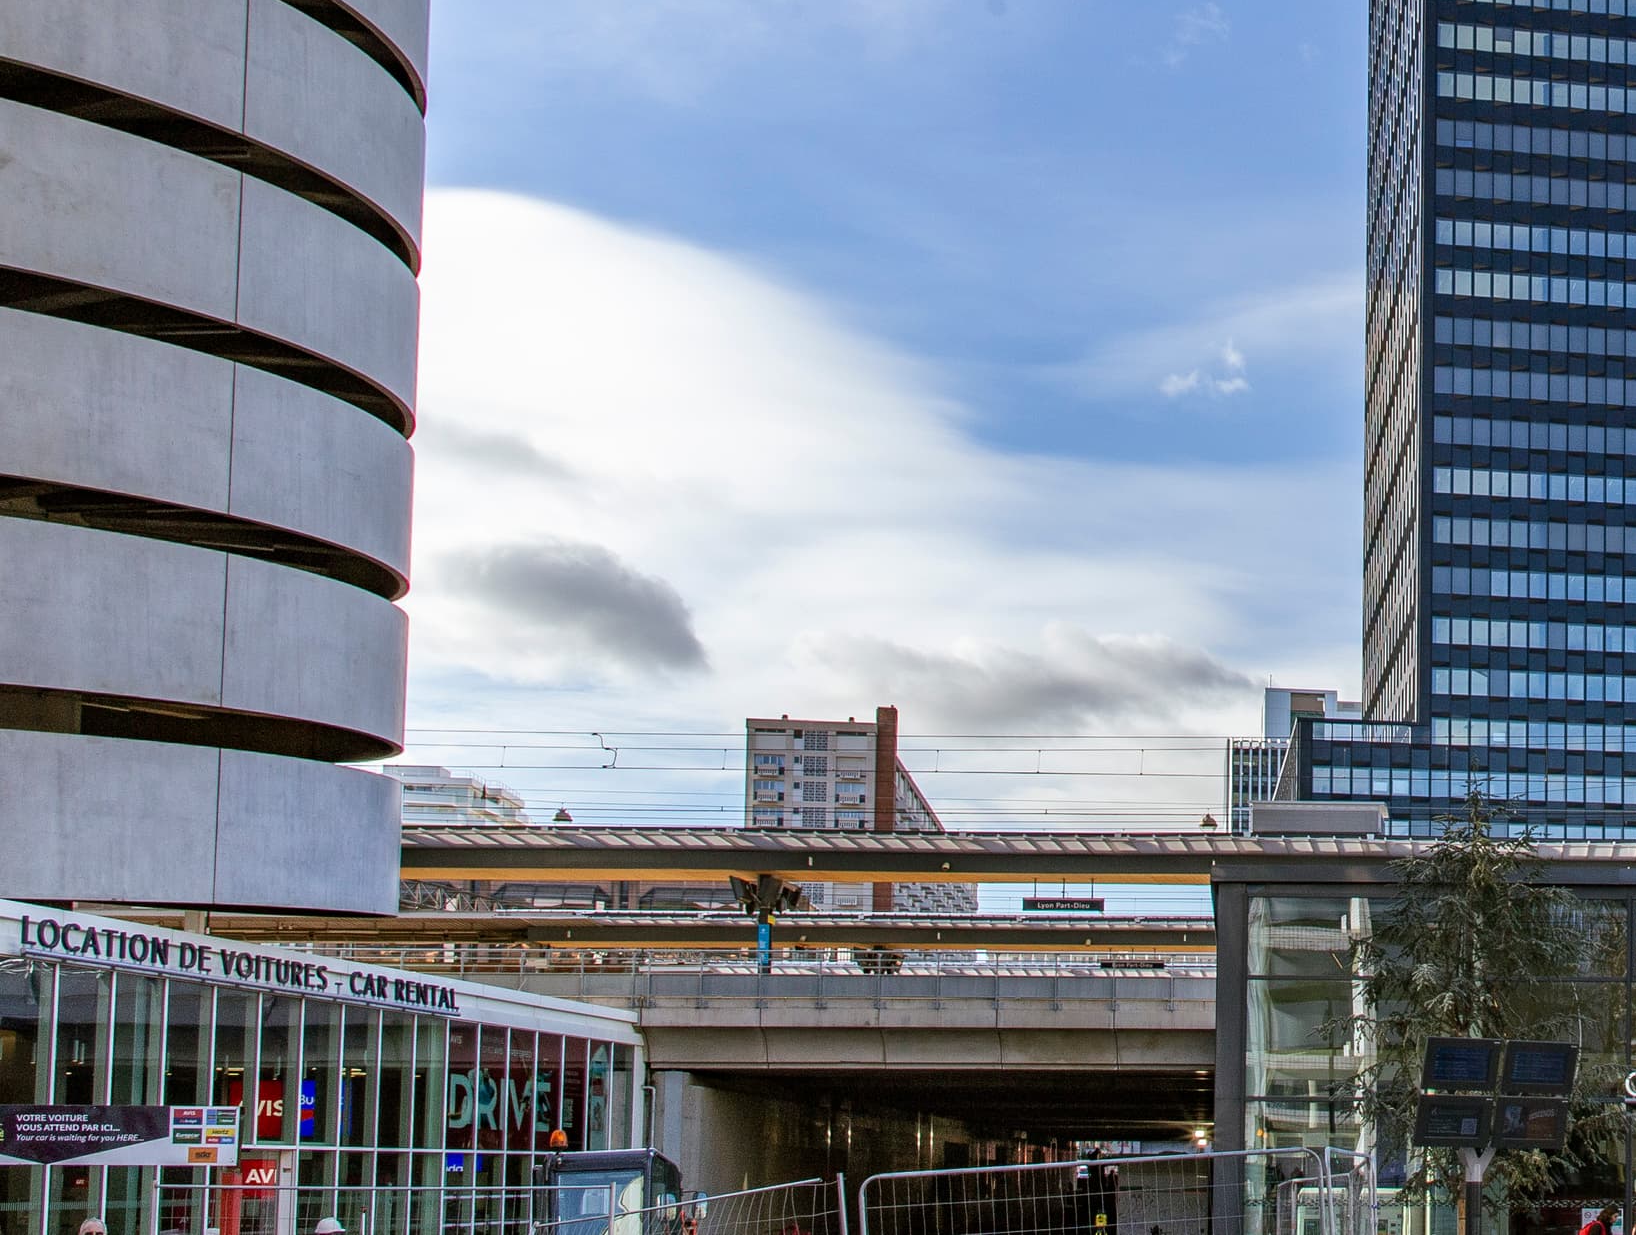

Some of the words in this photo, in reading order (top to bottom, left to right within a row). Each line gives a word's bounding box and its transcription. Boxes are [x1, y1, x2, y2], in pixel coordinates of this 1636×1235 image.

[21, 915, 169, 965] LOCATION
[180, 942, 212, 973] DE
[220, 949, 328, 990] VOITURES
[350, 971, 388, 999] CAR
[395, 979, 459, 1010] RENTAL
[449, 1073, 551, 1132] DRIVE
[16, 1114, 46, 1122] VOTRE
[48, 1114, 88, 1122] VOITURE
[16, 1124, 42, 1132] VOUS
[44, 1124, 79, 1132] ATTEND
[82, 1124, 98, 1132] PAR
[101, 1124, 120, 1132] ICI...
[16, 1134, 34, 1142] Your
[50, 1134, 56, 1142] is
[57, 1134, 87, 1144] waiting
[88, 1134, 99, 1143] for
[100, 1135, 115, 1144] you
[116, 1134, 144, 1142] HERE...
